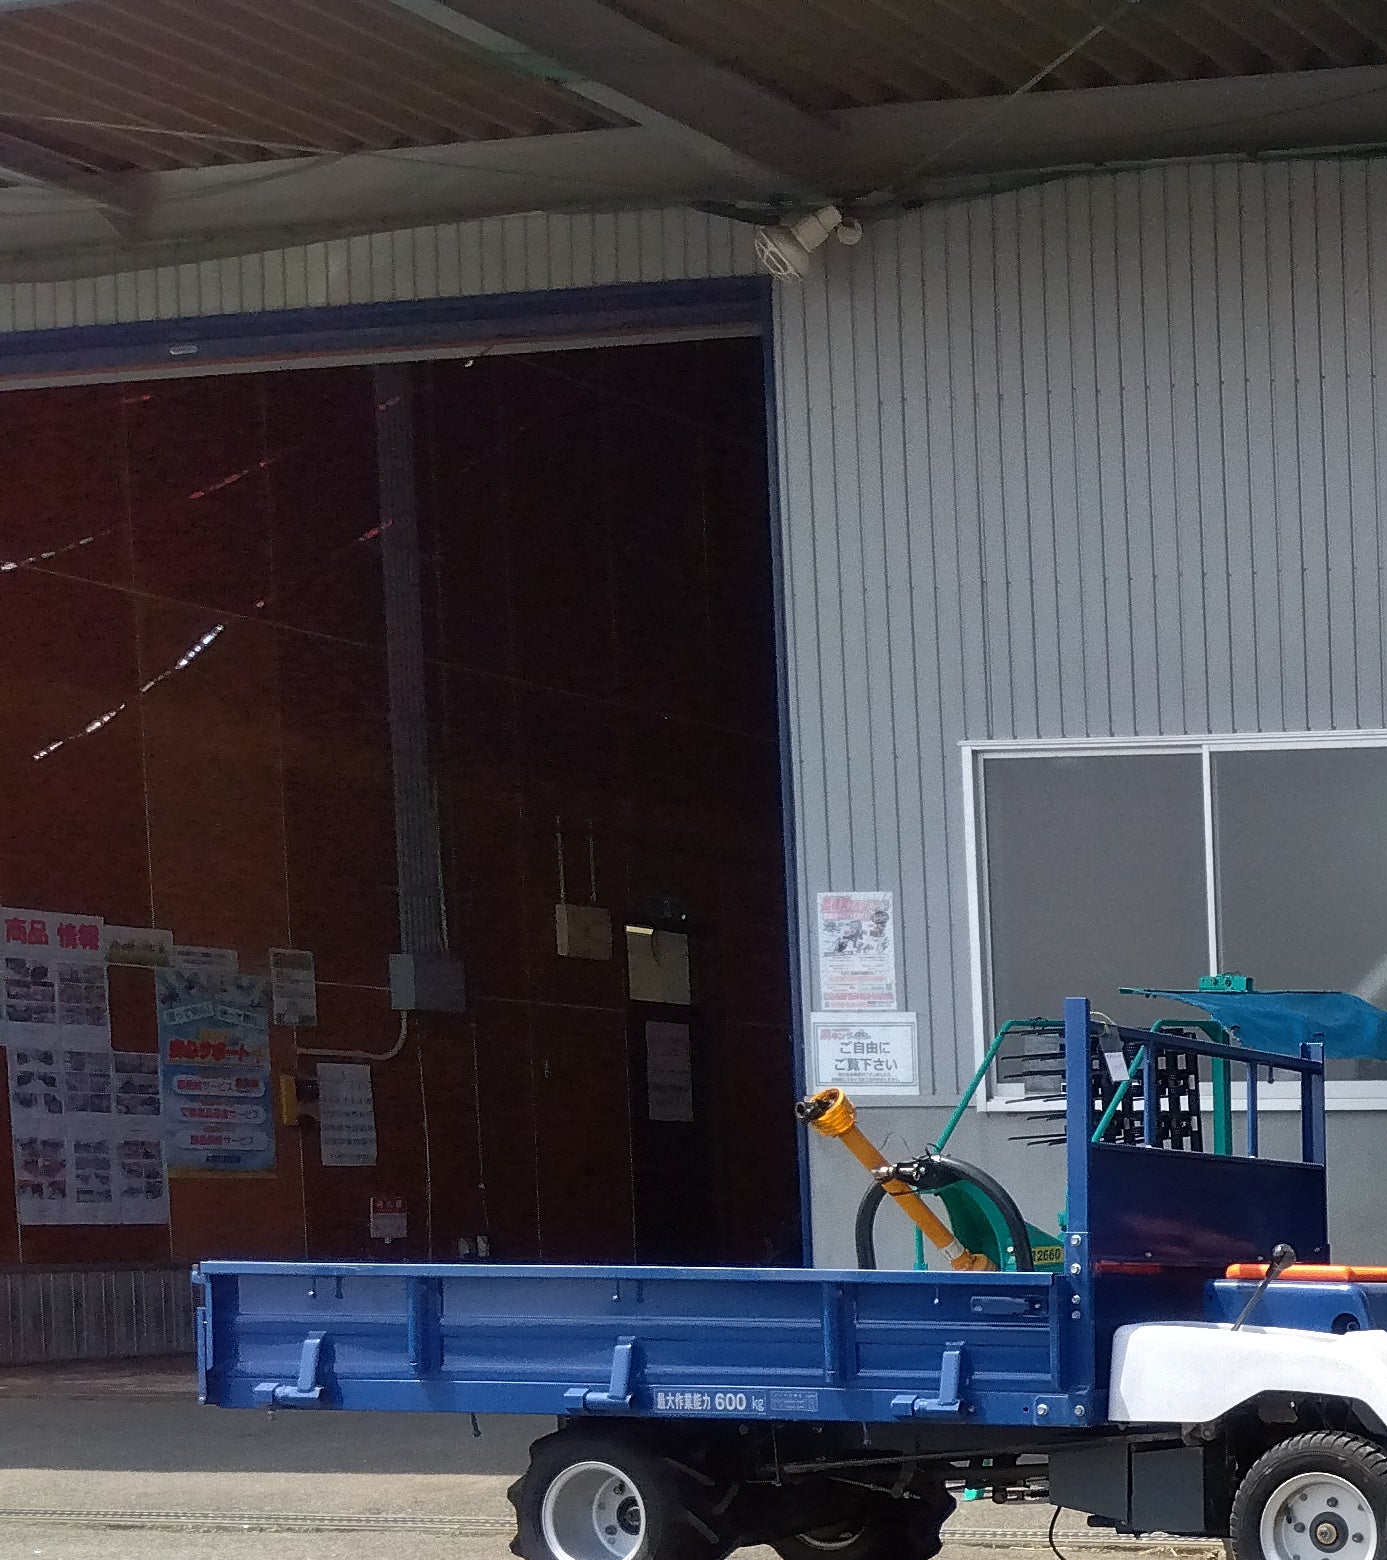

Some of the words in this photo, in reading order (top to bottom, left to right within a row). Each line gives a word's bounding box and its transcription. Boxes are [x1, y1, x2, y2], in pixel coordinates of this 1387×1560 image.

[840, 1041, 891, 1054] ご自由に
[834, 1057, 898, 1071] ご覧下さい
[656, 1392, 711, 1410] 最大作業能力
[714, 1393, 747, 1411] 600
[751, 1395, 765, 1412] kg
